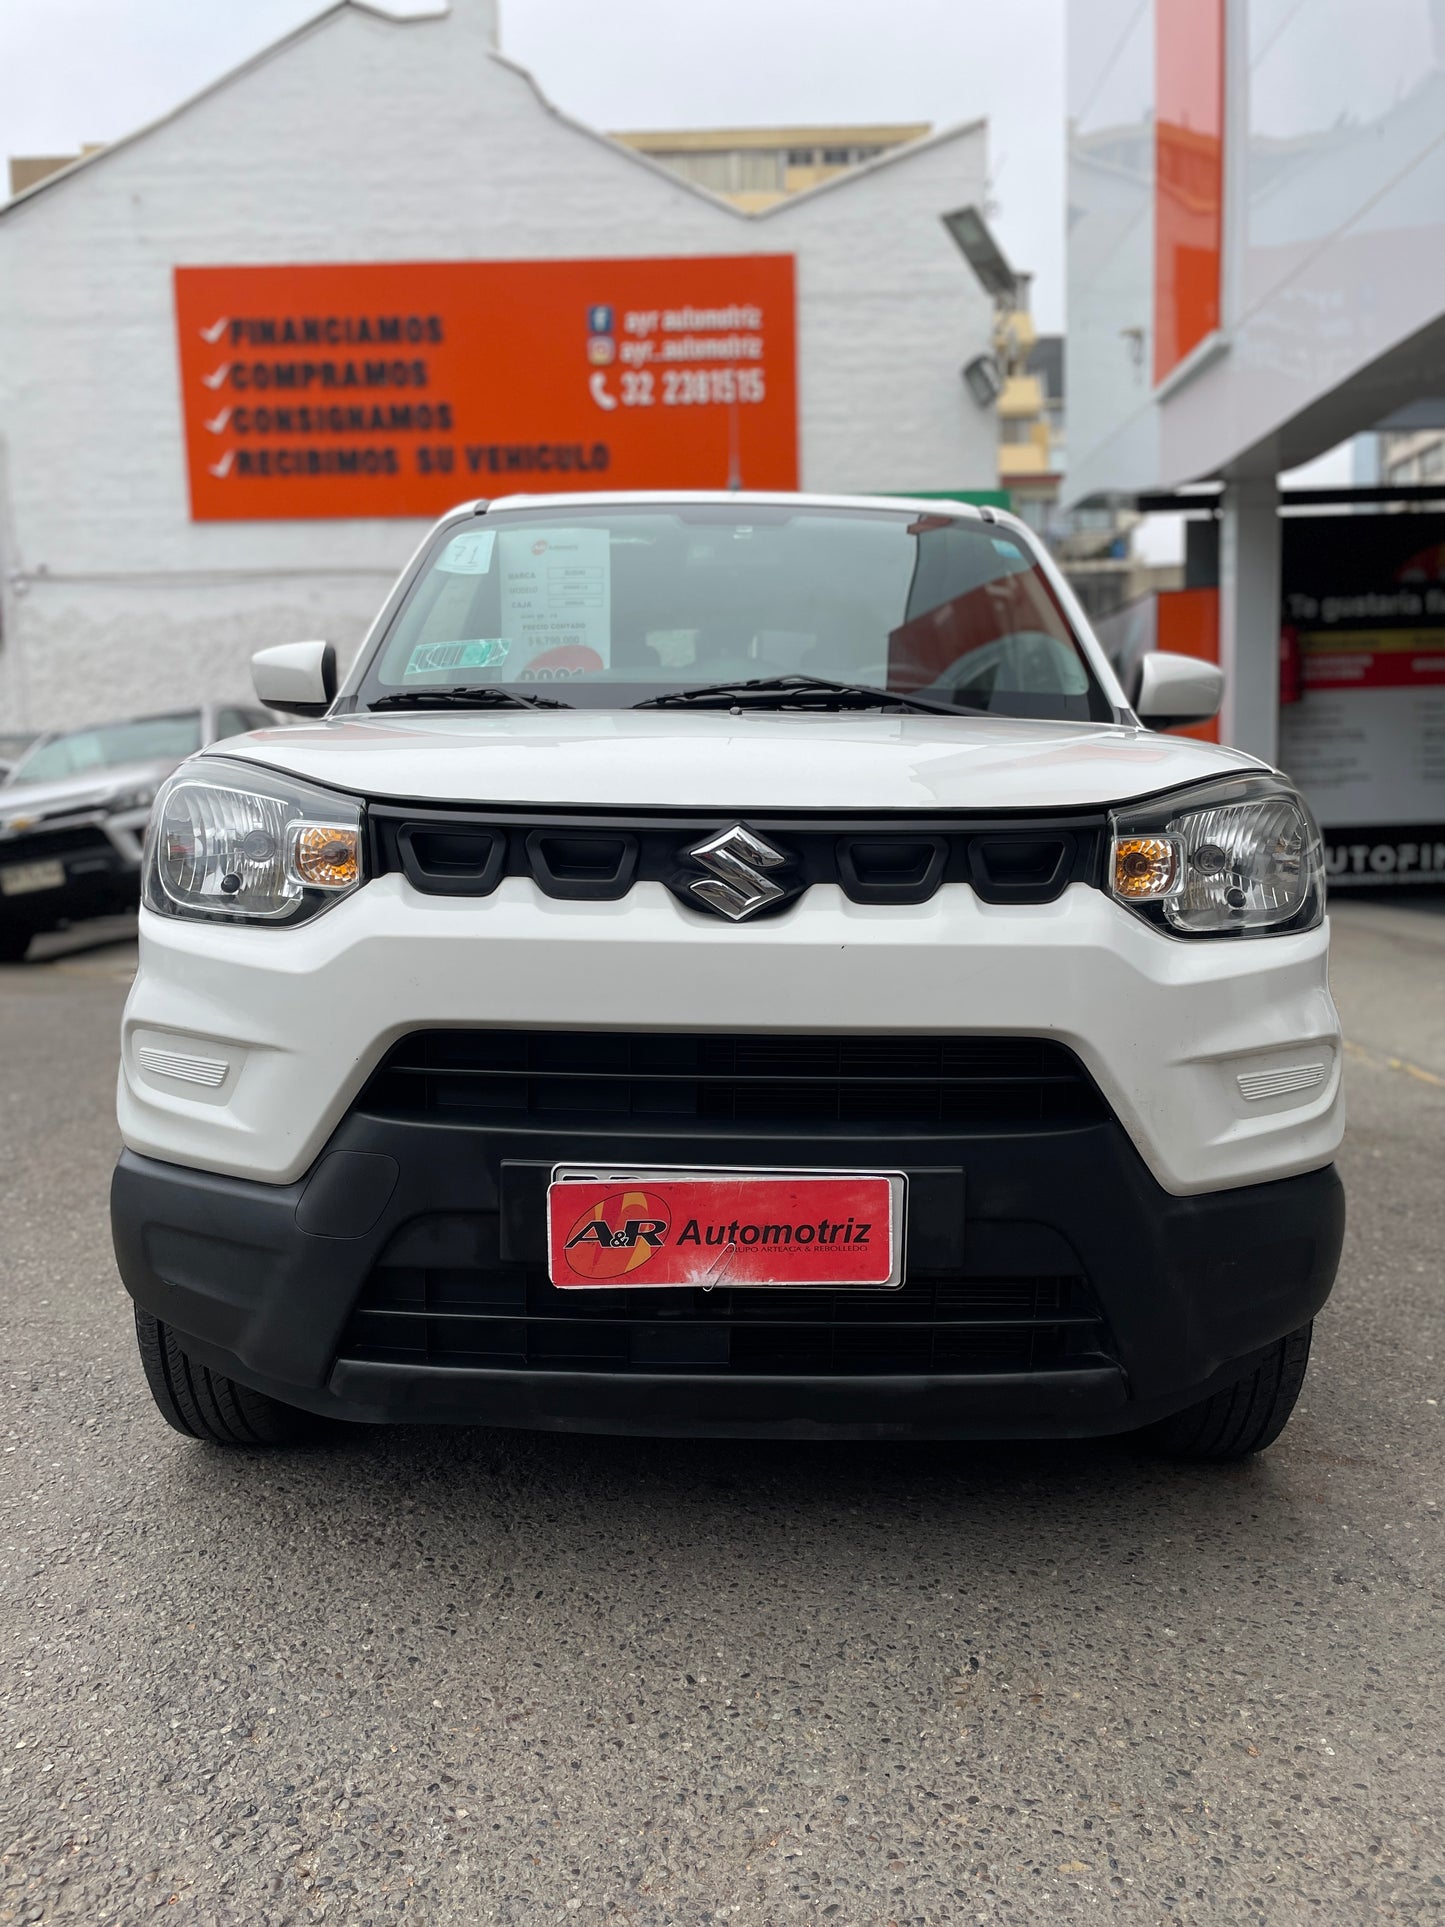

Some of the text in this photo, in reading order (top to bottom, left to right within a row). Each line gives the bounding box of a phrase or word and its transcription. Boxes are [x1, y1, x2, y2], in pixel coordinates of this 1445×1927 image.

[230, 316, 443, 346] FINANCIAMOS
[624, 304, 763, 338] ayr automotriz
[230, 361, 428, 390] COMPRAMOS
[620, 370, 655, 406] 32
[231, 403, 453, 434] CONSIGNAMOS
[236, 443, 610, 477] RECIBIMOS SU VEHICULO
[511, 600, 532, 609] CAJA
[522, 623, 549, 631] PRECIO
[563, 1217, 872, 1248] A&R Automotriz
